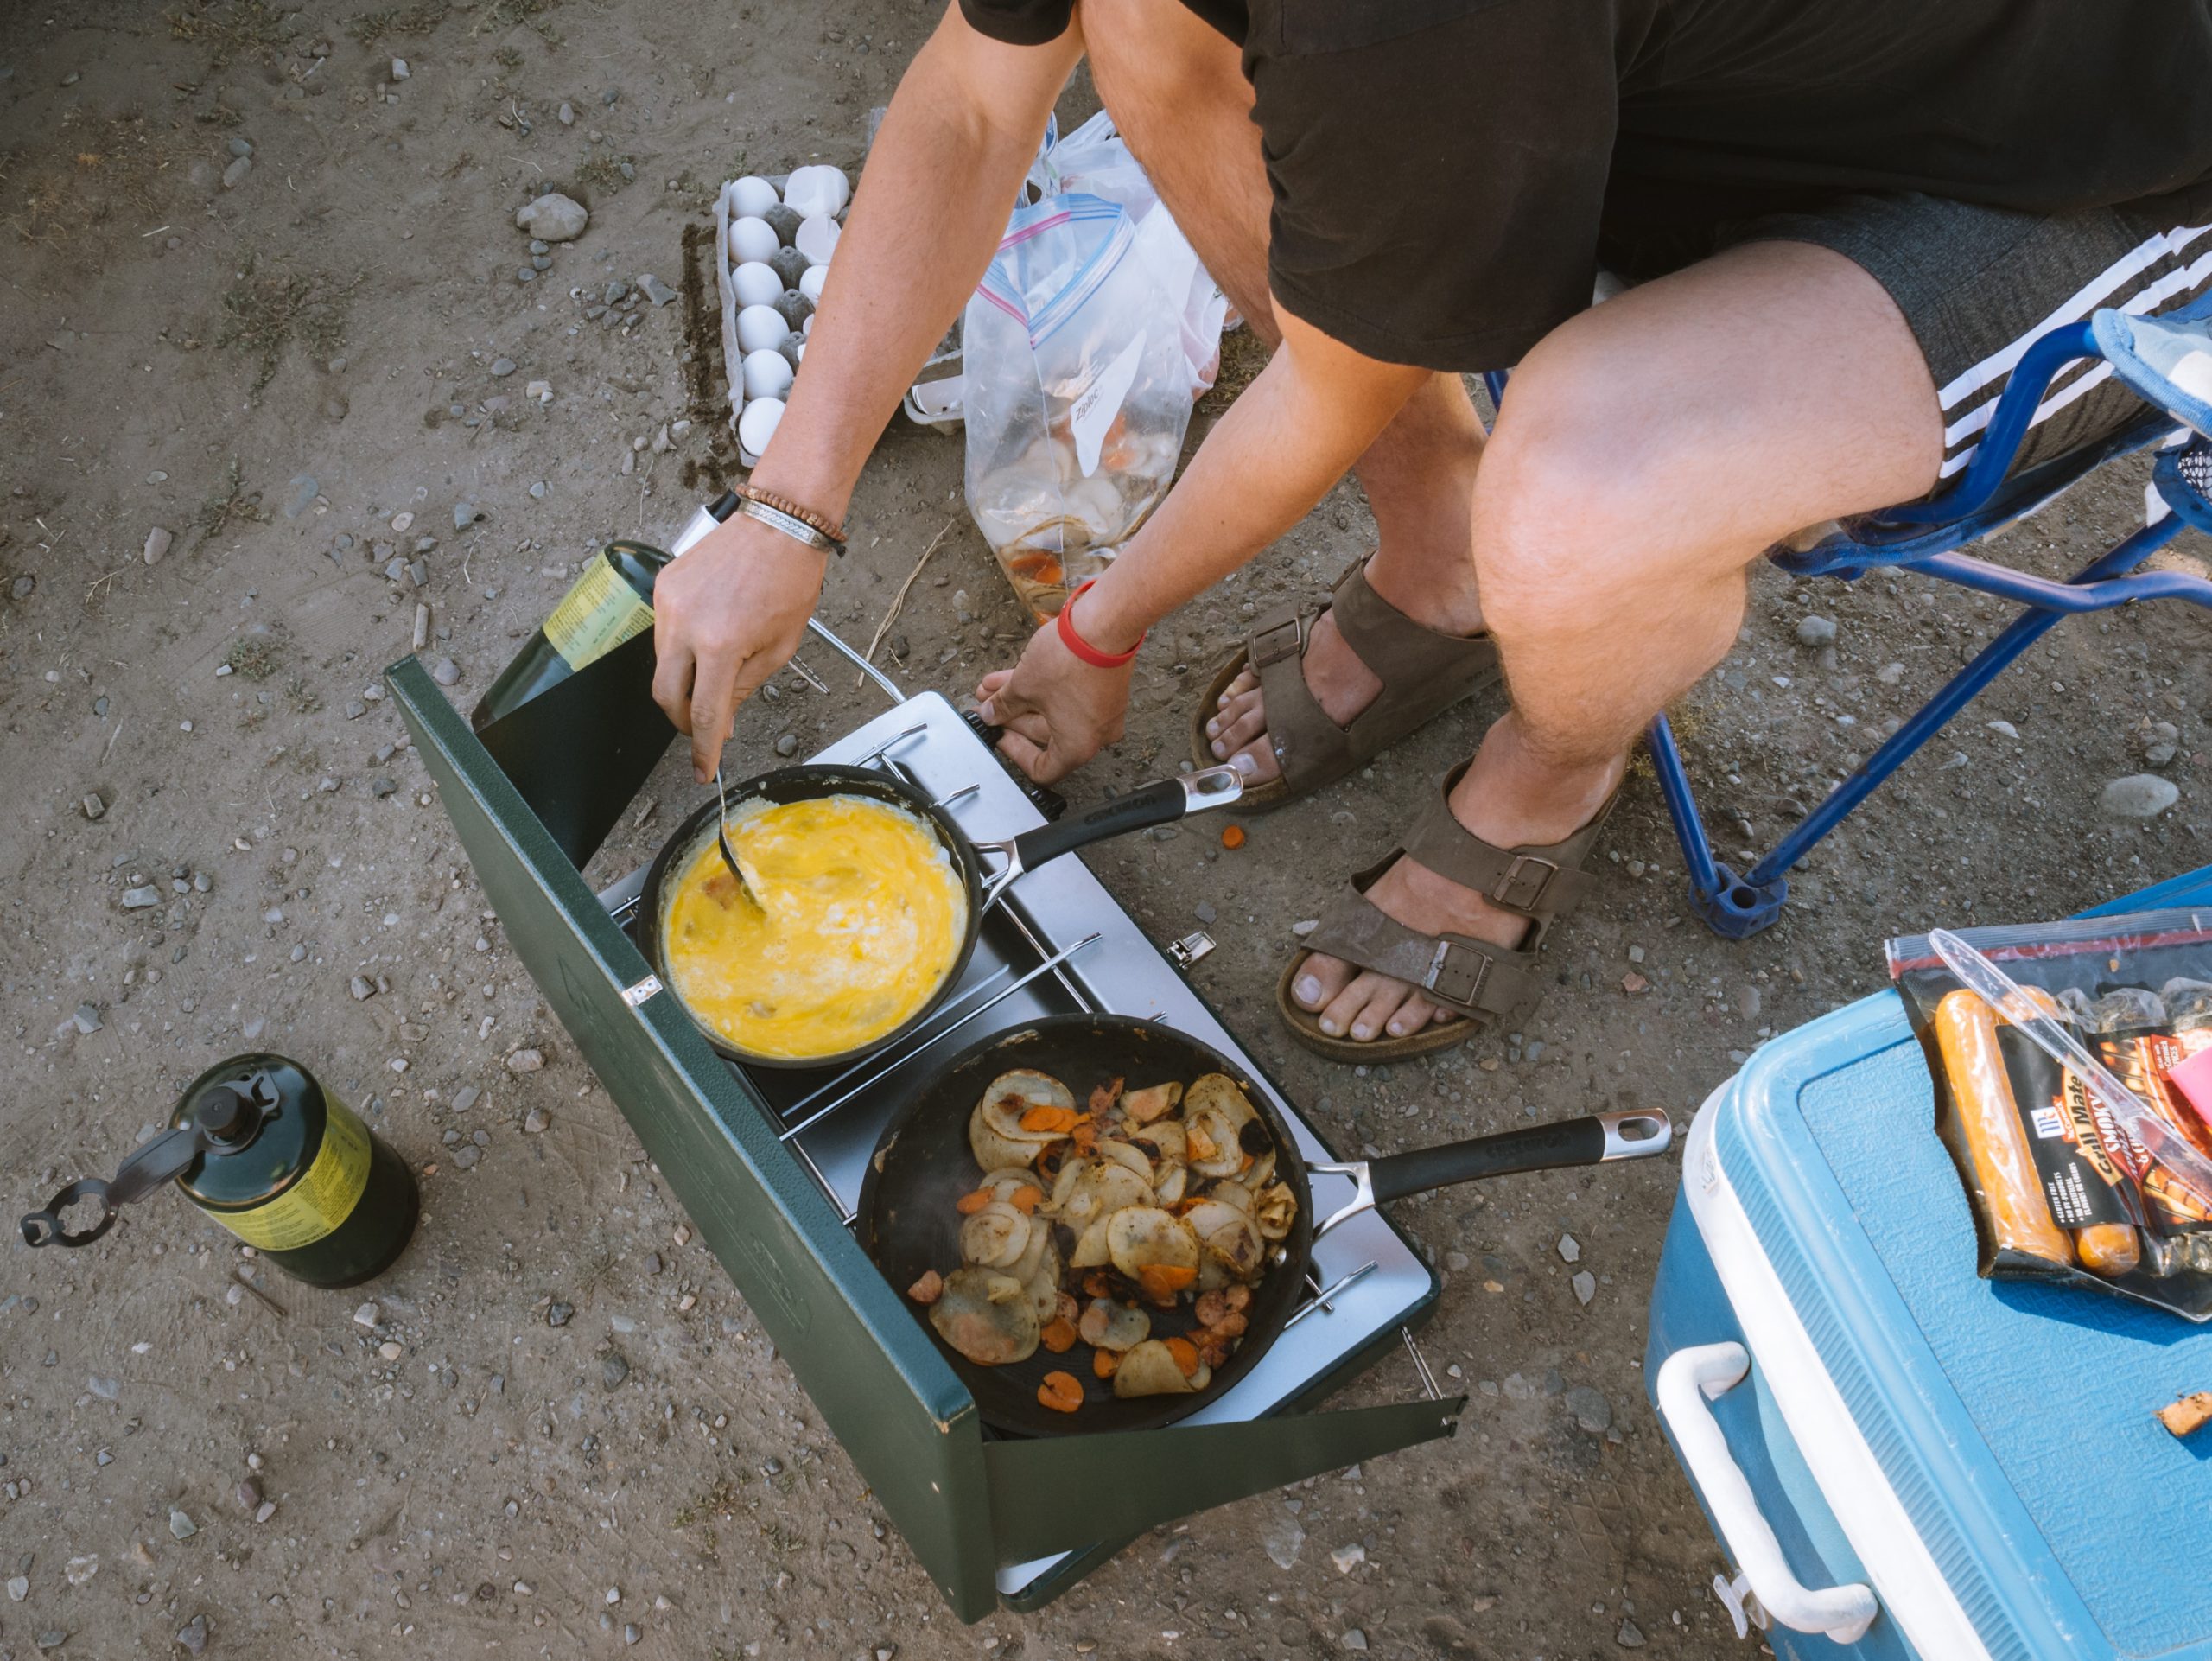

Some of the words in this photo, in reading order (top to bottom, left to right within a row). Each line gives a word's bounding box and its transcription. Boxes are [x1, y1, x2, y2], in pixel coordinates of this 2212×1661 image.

[1075, 387, 1100, 423] Ziploc
[2067, 1074, 2092, 1125] Mate
[2056, 1100, 2075, 1140] McCormick
[2088, 1090, 2121, 1153] SMOKY
[2079, 1132, 2113, 1174] Grill
[2068, 1161, 2082, 1183] COLORS
[2047, 1181, 2058, 1196] FREE
[2053, 1171, 2072, 1210] BY-PRODUCTS
[2065, 1177, 2082, 1208] ARTIFICIAL
[2075, 1182, 2084, 1192] OR
[2052, 1196, 2065, 1219] GLUTEN
[2065, 1209, 2074, 1219] NO
[2075, 1208, 2083, 1218] NO
[2078, 1192, 2093, 1216] FLAVORS
